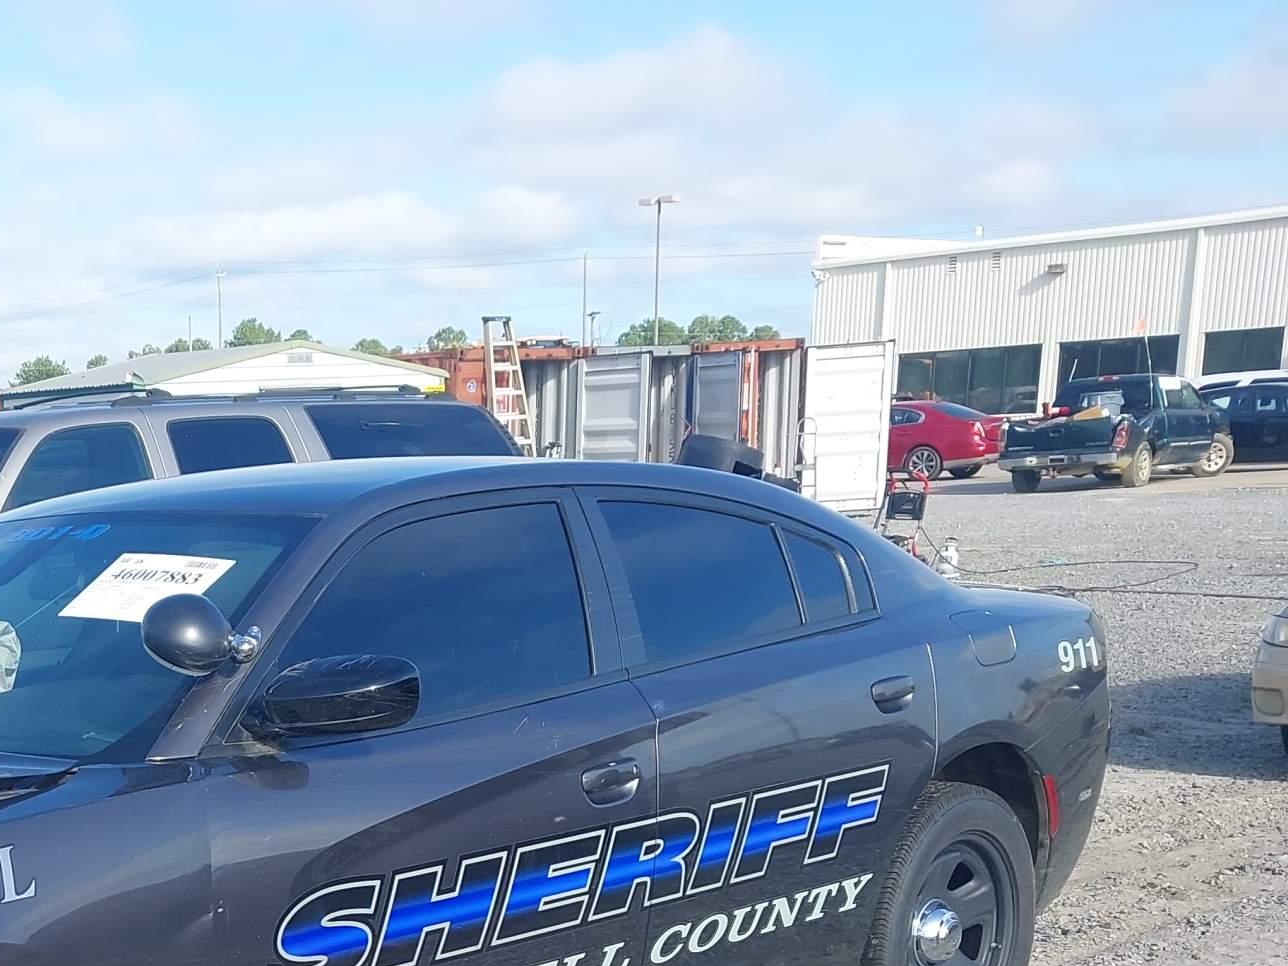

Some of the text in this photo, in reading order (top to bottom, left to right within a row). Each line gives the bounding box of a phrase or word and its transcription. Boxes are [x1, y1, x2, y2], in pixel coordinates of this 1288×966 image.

[112, 568, 203, 585] 46007883
[1057, 636, 1099, 673] 911
[649, 873, 874, 966] COUNTY
